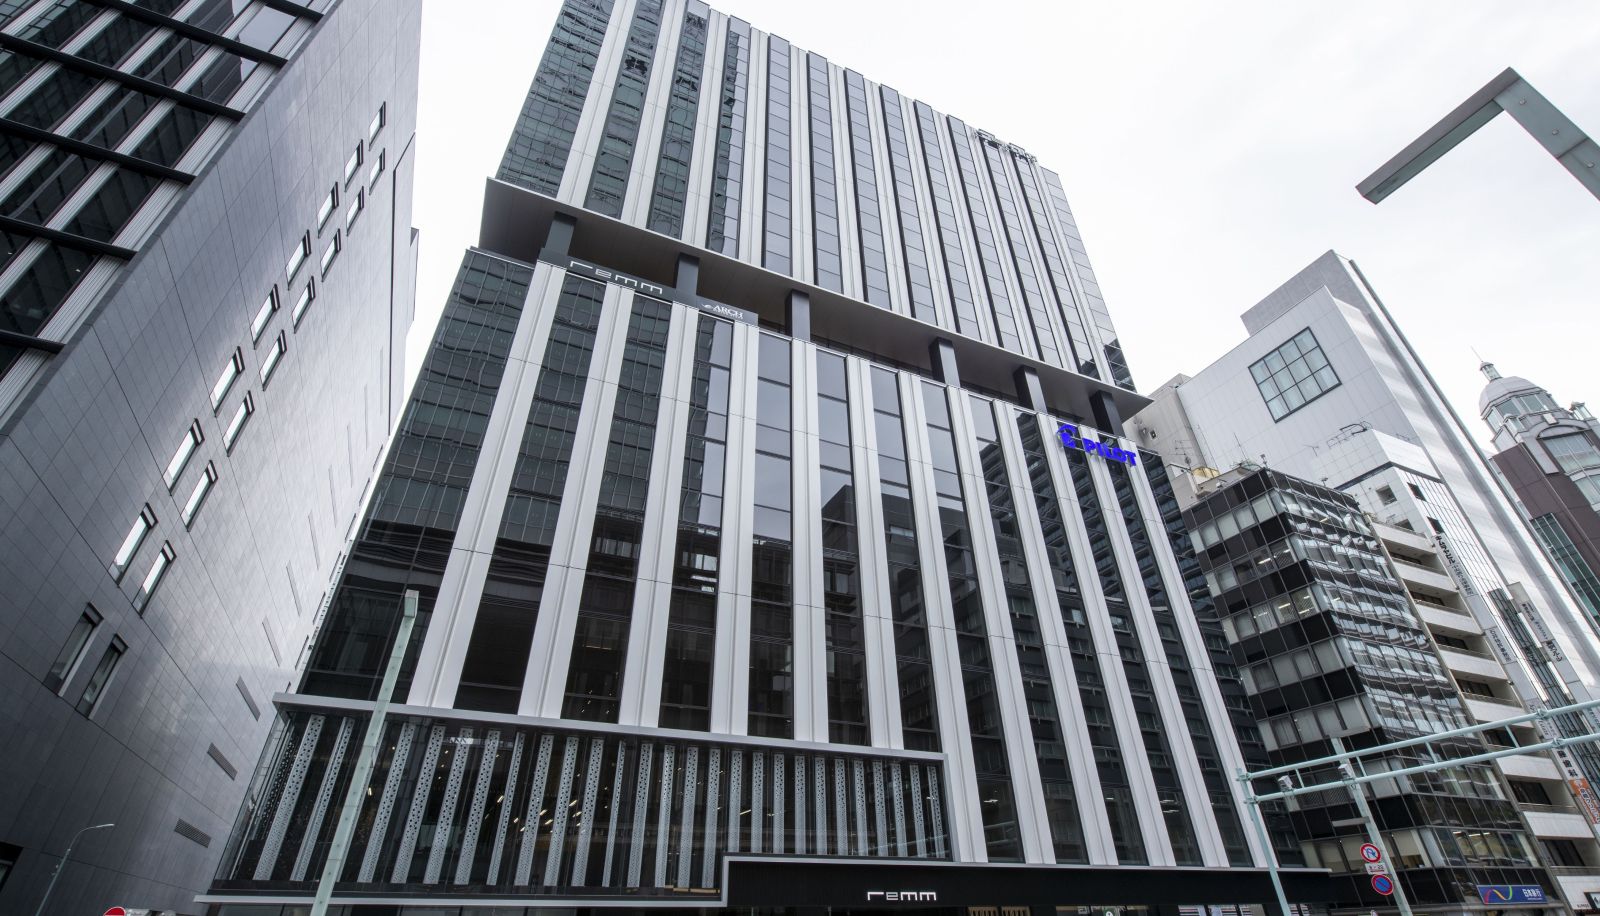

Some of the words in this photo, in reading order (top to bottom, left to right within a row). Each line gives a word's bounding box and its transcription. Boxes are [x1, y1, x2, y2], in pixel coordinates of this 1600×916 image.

[570, 261, 662, 294] remm
[1082, 438, 1136, 466] PILOT
[867, 891, 936, 901] remm
